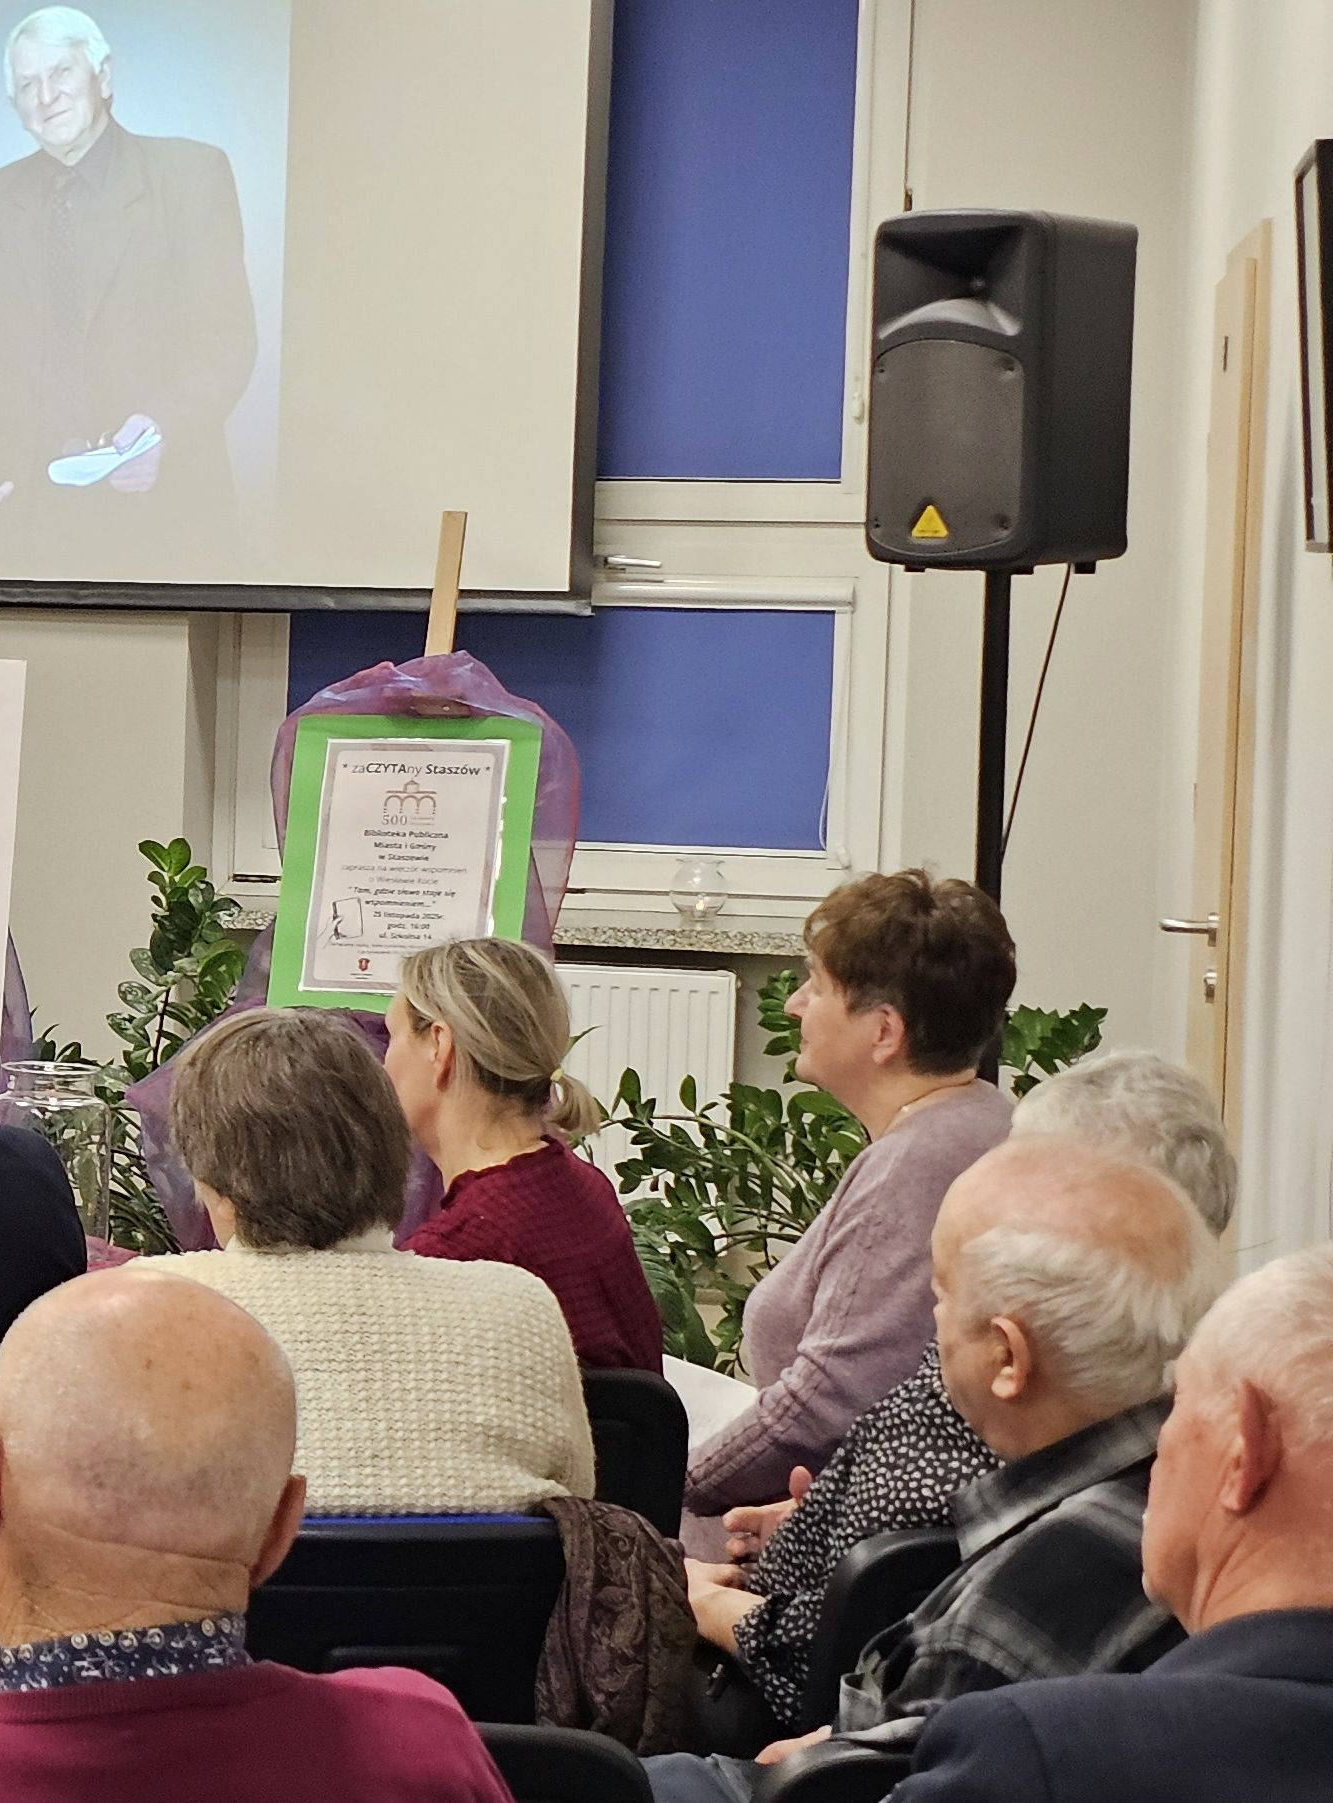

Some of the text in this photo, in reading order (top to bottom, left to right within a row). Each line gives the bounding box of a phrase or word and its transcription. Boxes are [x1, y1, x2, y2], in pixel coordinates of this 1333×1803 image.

[352, 763, 480, 777] zaCZYTAny Staszów
[381, 814, 408, 826] 500
[364, 829, 449, 839] Biblioteka Publiczna
[409, 843, 437, 851] Gminy
